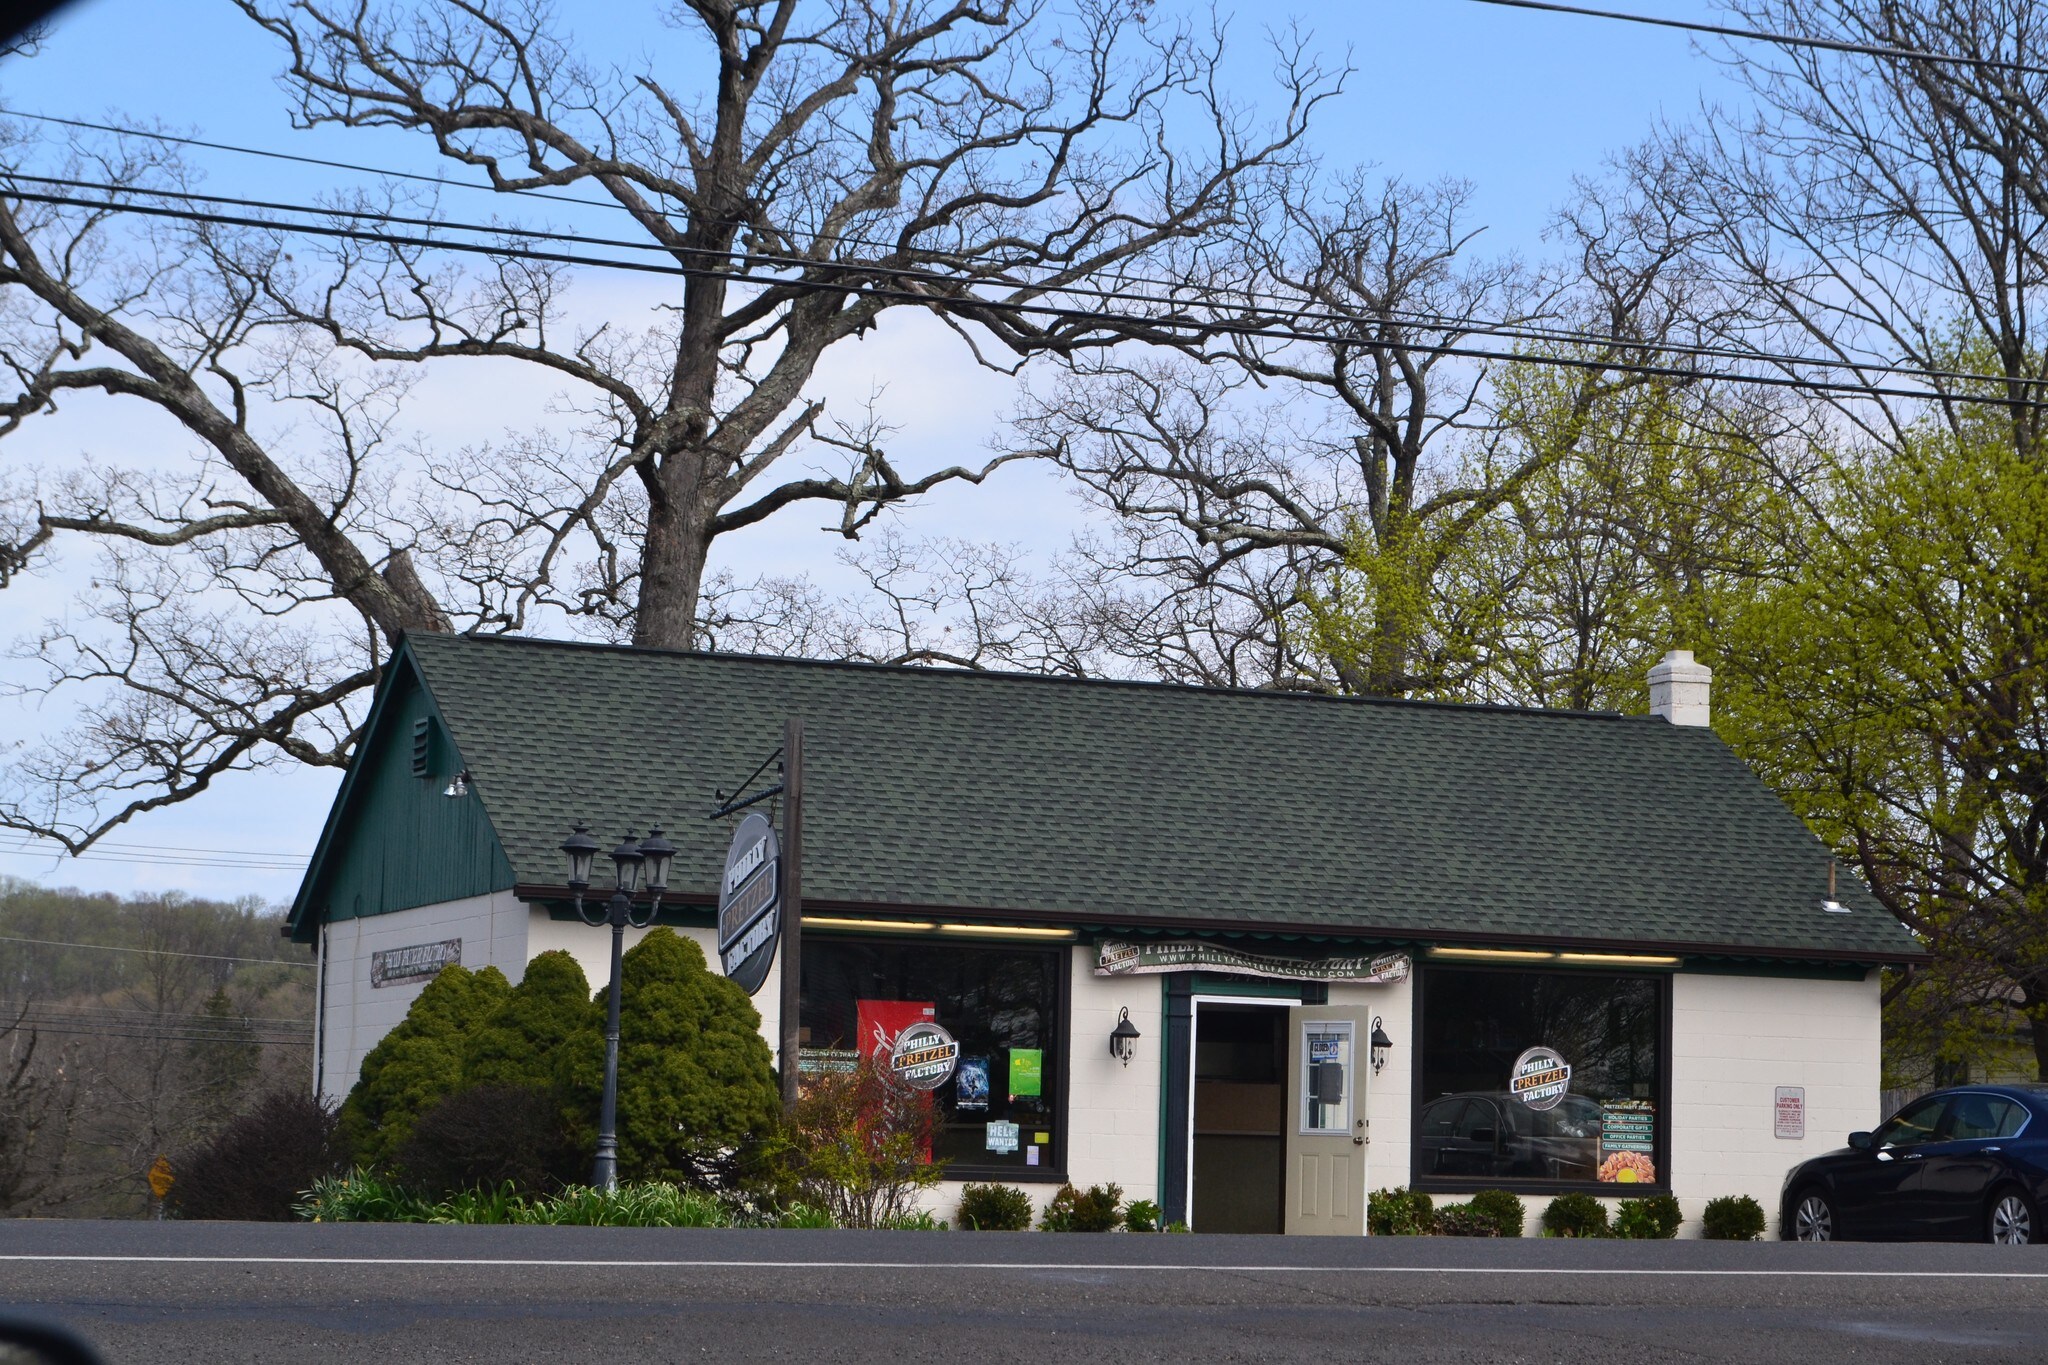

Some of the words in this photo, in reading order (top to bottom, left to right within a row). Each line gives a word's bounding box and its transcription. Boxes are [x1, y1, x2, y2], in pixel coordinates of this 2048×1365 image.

[727, 836, 767, 895] PHILLY
[725, 873, 771, 937] PRETZEL
[727, 908, 776, 976] FACTORY
[1104, 948, 1138, 964] PRETZEL
[1109, 959, 1138, 972] FACTORY
[903, 1034, 941, 1051] PHILLY
[898, 1046, 952, 1067] PRETZEL
[1521, 1058, 1555, 1074] PHILLY
[905, 1061, 951, 1080] FACTORY
[1517, 1069, 1565, 1089] PRETZEL
[1523, 1083, 1565, 1102] FACTORY
[990, 1125, 1016, 1137] HELP
[988, 1137, 1018, 1147] WANTED
